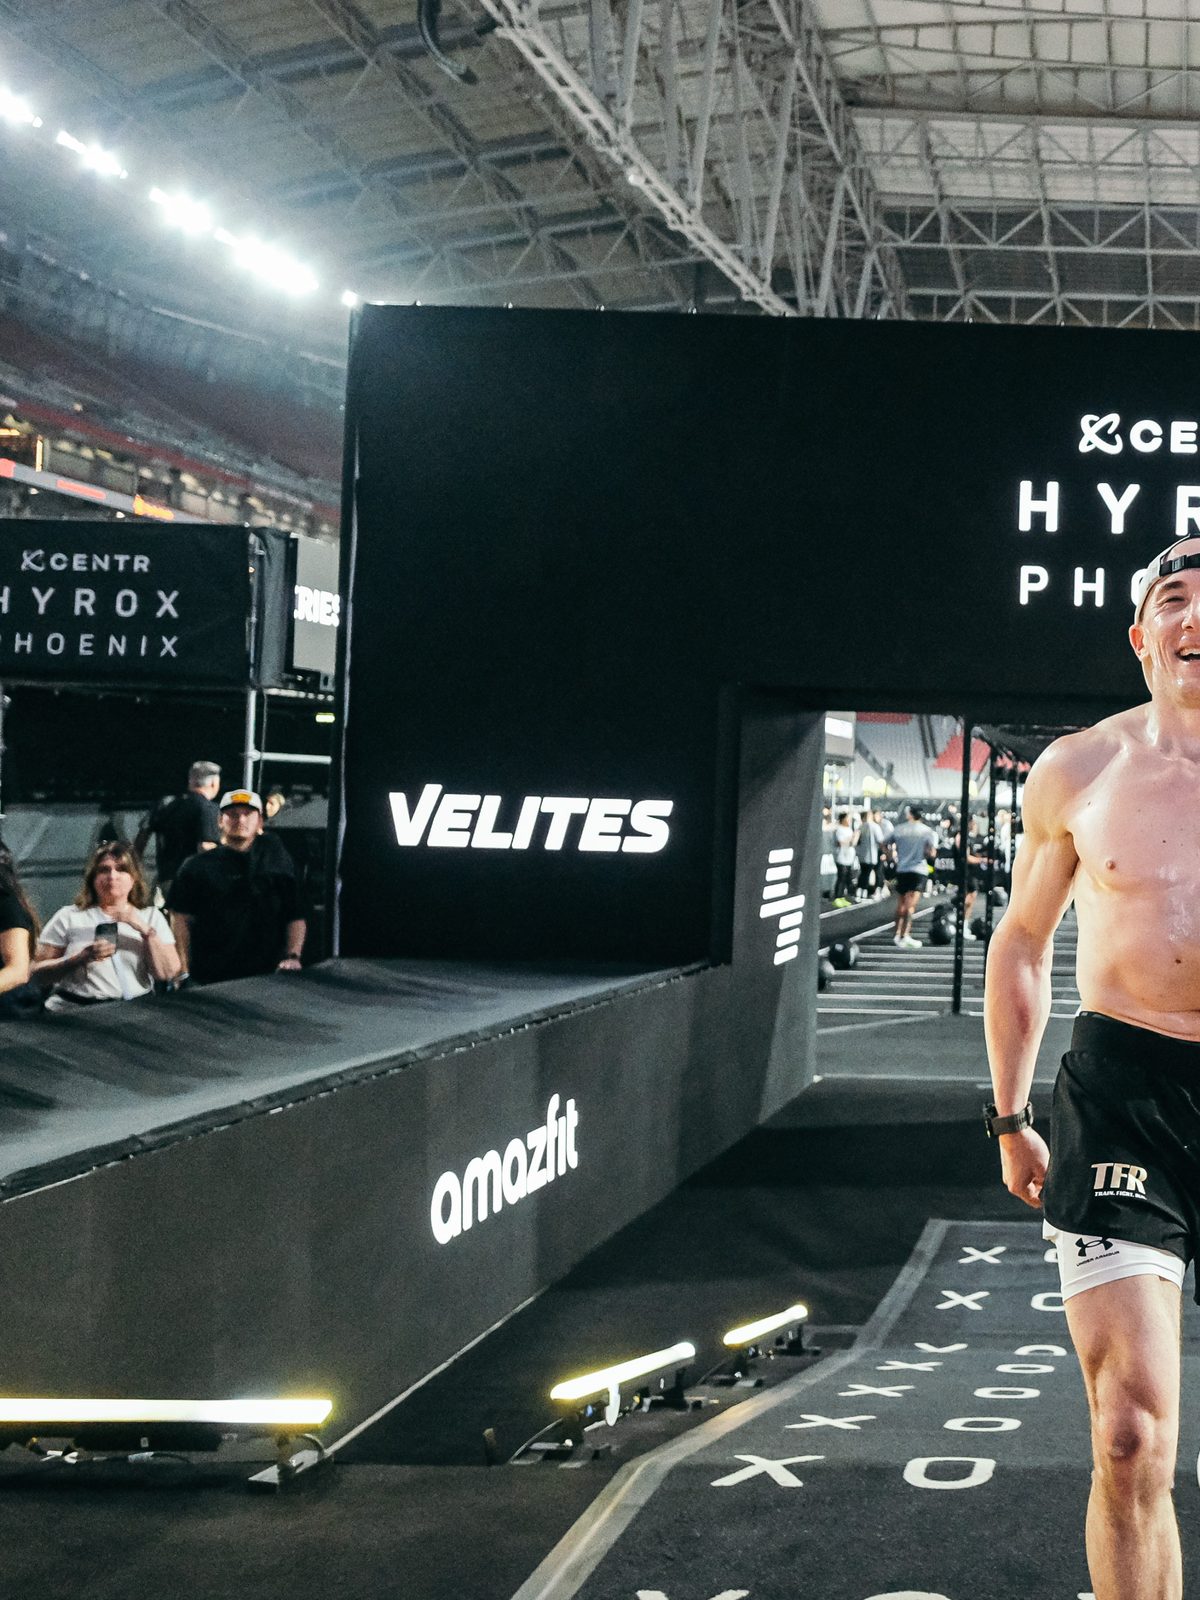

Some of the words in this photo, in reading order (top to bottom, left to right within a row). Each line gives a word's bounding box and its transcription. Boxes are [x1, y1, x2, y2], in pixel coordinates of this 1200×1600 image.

[50, 552, 150, 573] CENTR
[0, 632, 178, 658] HOENIX
[388, 783, 674, 854] VELITES
[430, 1093, 579, 1245] amazfit
[1090, 1162, 1148, 1195] TFR
